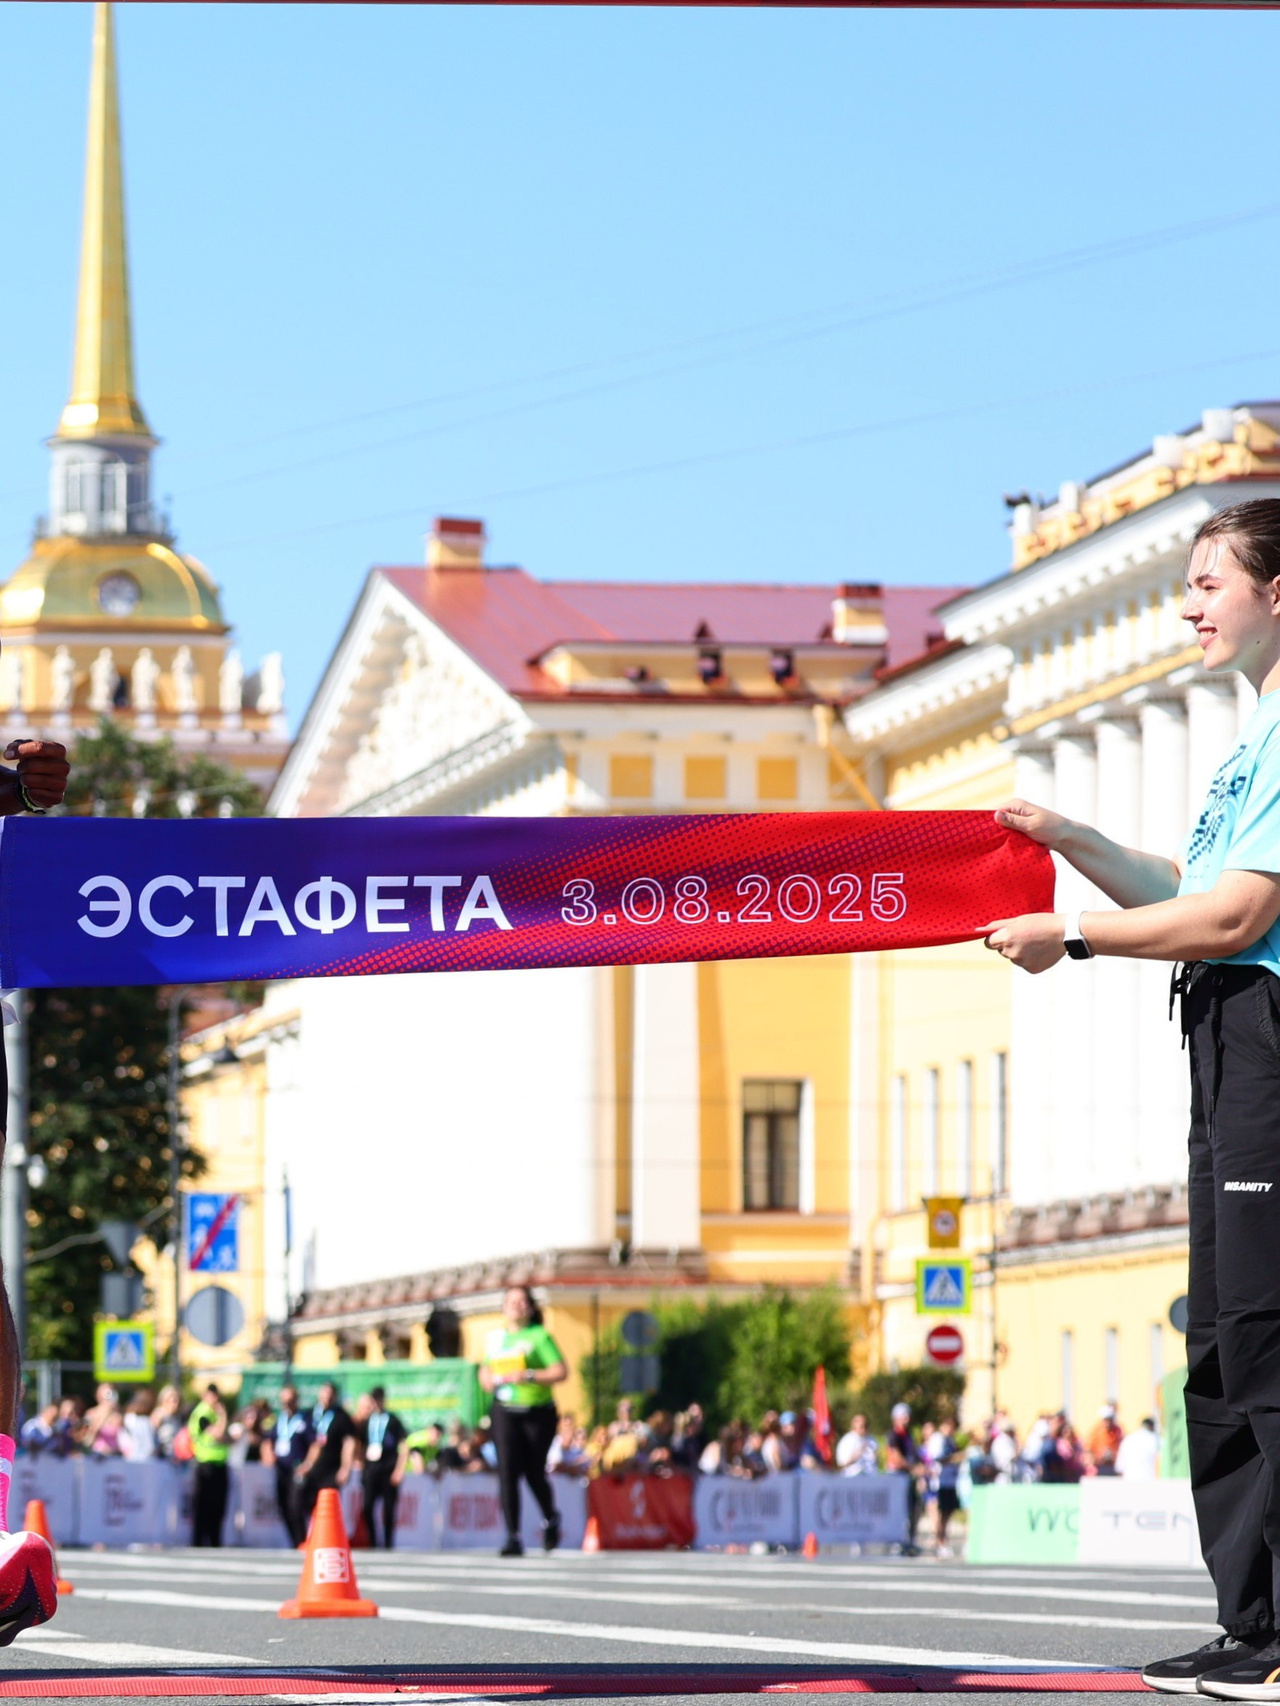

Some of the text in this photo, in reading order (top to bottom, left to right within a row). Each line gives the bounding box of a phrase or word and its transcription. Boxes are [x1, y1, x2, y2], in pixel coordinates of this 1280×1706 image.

[76, 872, 908, 938] ЭСТАФЕТА 3.08.2025
[1224, 1181, 1273, 1192] INSANITY
